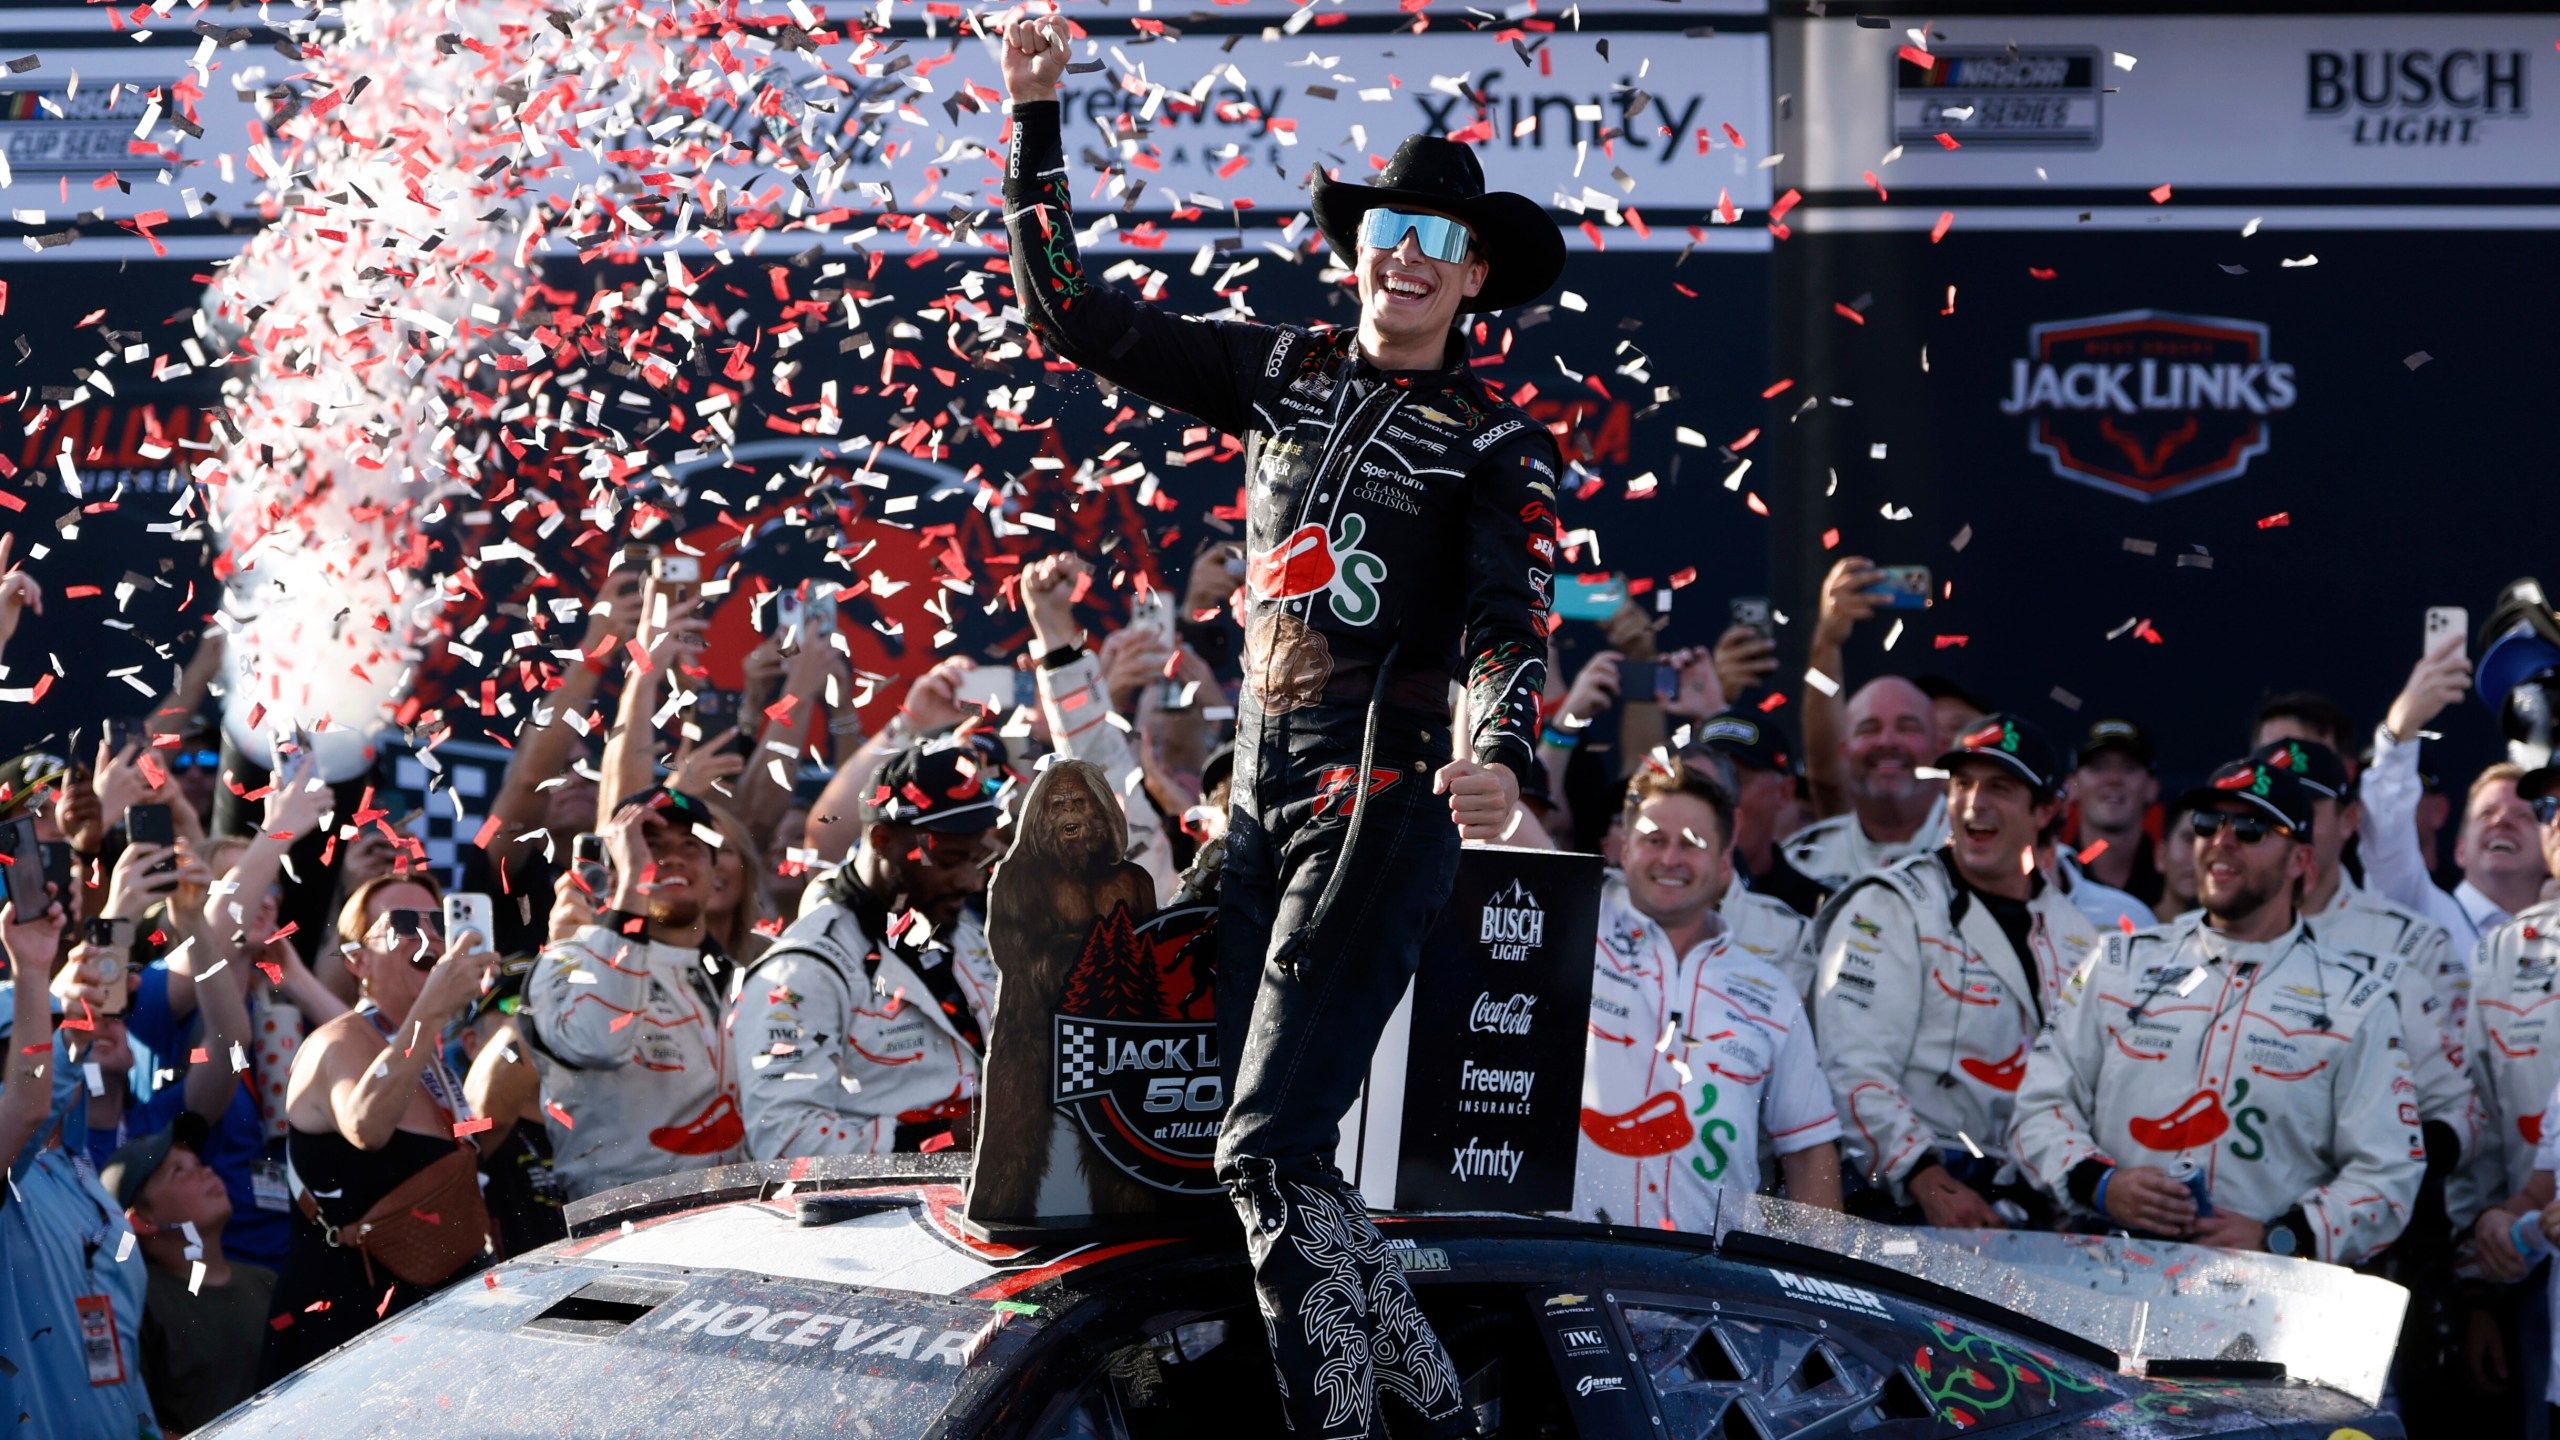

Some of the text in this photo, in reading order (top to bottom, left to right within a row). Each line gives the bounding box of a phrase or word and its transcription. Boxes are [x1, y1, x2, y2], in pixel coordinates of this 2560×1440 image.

[2306, 49, 2530, 118] BUSCH
[1058, 82, 1284, 139] reeway
[1411, 70, 1705, 163] xfinity
[65, 130, 152, 159] SERIE
[2352, 117, 2476, 145] LIGHT
[1010, 121, 1023, 180] sparco
[1265, 329, 1296, 378] sparco
[2001, 357, 2298, 414] JACK LINK'S
[1397, 411, 1459, 439] CHEVROLET
[1472, 420, 1525, 452] sparco
[1360, 461, 1424, 491] Spectrum
[1365, 480, 1414, 503] CLASSIC
[1353, 487, 1421, 516] COLLISION
[1311, 764, 1401, 817] 77
[1480, 906, 1544, 947] BUSCH
[1491, 945, 1529, 961] LIGHT
[1469, 991, 1537, 1036] Coca-Cola
[1098, 1035, 1193, 1075] JACK
[1142, 1075, 1224, 1113] 50
[1461, 1060, 1535, 1101] Freeway
[1458, 1100, 1531, 1115] INSURANCE
[1154, 1121, 1224, 1139] at TALLAD
[1450, 1136, 1524, 1184] xfinity
[1768, 1268, 1887, 1311] MINER
[1546, 1307, 1595, 1316] CHEVROLET
[1849, 1305, 1867, 1314] AND
[659, 1298, 970, 1367] HOCEVAR
[1564, 1330, 1602, 1347] TWG
[1576, 1375, 1622, 1397] Garner
